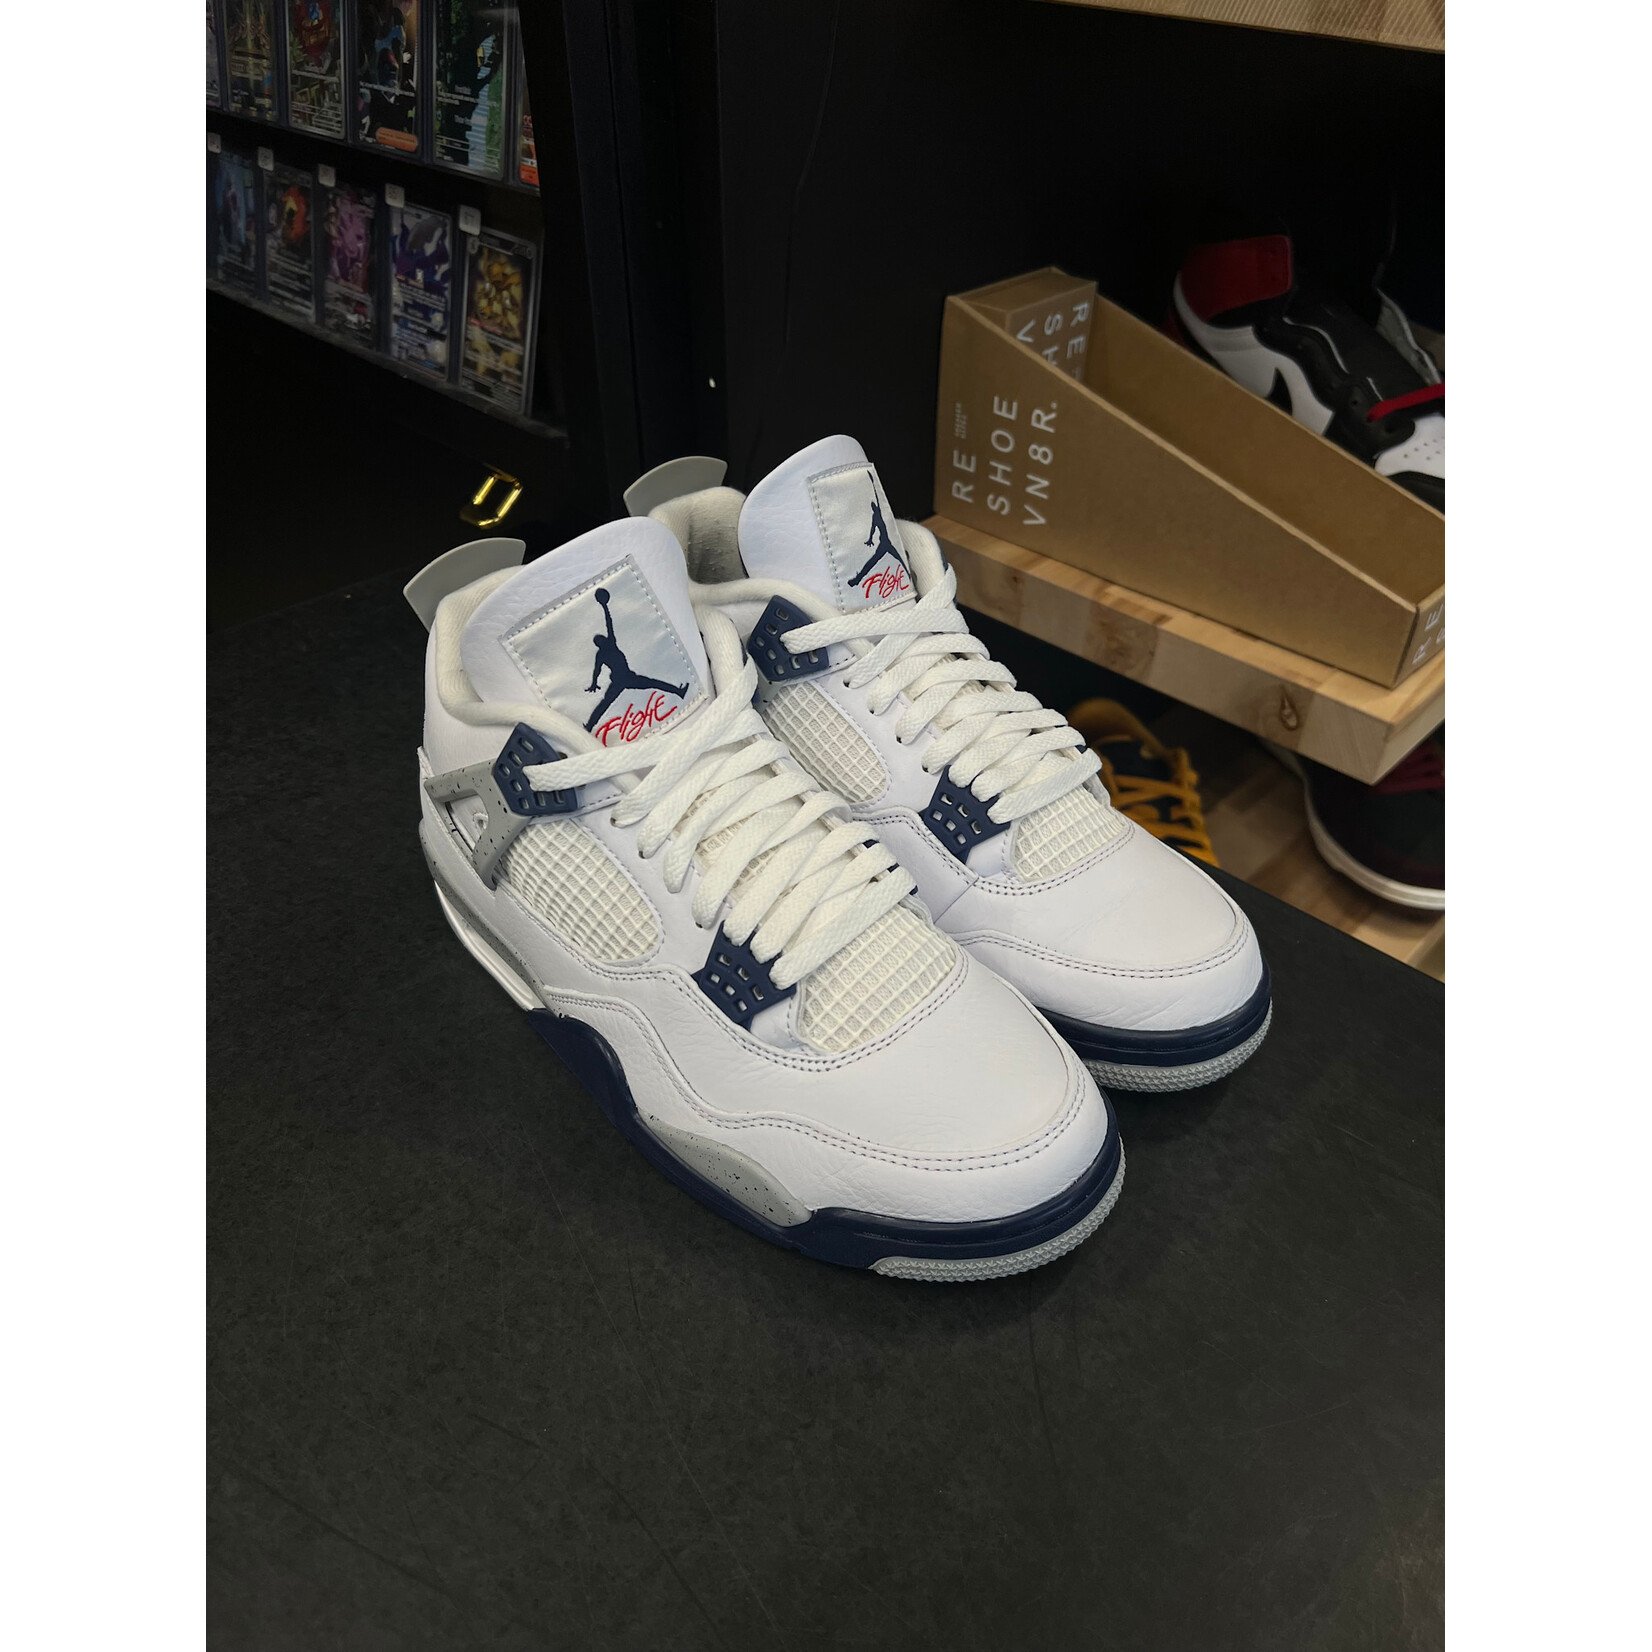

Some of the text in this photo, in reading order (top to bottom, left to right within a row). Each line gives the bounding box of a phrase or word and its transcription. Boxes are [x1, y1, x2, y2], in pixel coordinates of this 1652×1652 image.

[1041, 312, 1063, 366] SH
[1066, 302, 1089, 359] RE
[951, 449, 977, 503] RE
[987, 396, 1018, 516] SHOE
[1022, 400, 1058, 526] VN8R.
[862, 563, 910, 599] Flight
[595, 690, 678, 747] Flight
